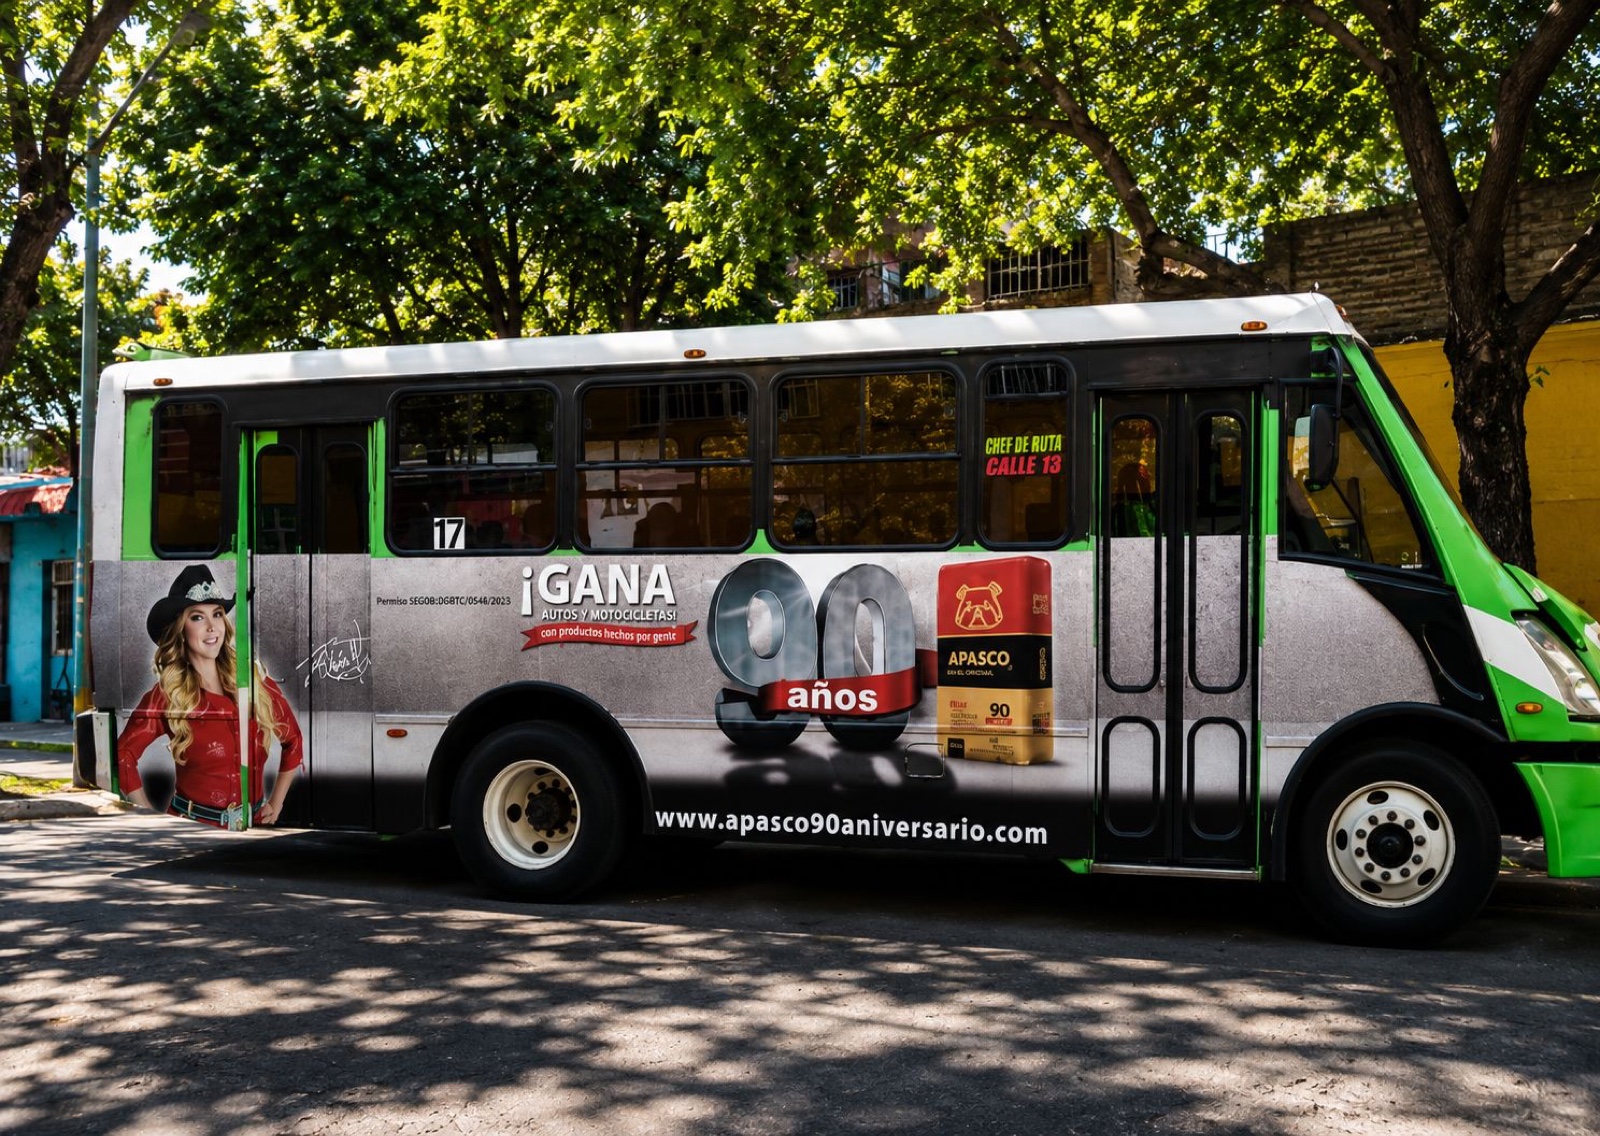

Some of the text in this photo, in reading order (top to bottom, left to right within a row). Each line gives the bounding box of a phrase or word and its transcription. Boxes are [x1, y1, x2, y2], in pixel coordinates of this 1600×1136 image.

[985, 434, 1062, 454] CHEF DE RUTA
[985, 454, 1062, 475] CALLE 13
[434, 518, 464, 549] 17
[521, 563, 676, 616] ¡GANA
[541, 609, 578, 622] AUTOS
[580, 609, 588, 622] Y
[540, 627, 557, 638] con
[559, 626, 602, 640] productos
[604, 629, 634, 642] hechos
[636, 631, 651, 644] por
[948, 650, 1010, 666] APASCO
[787, 681, 878, 712] años
[989, 702, 1011, 718] 90
[655, 810, 1048, 845] www.apasco90aniversario.com
